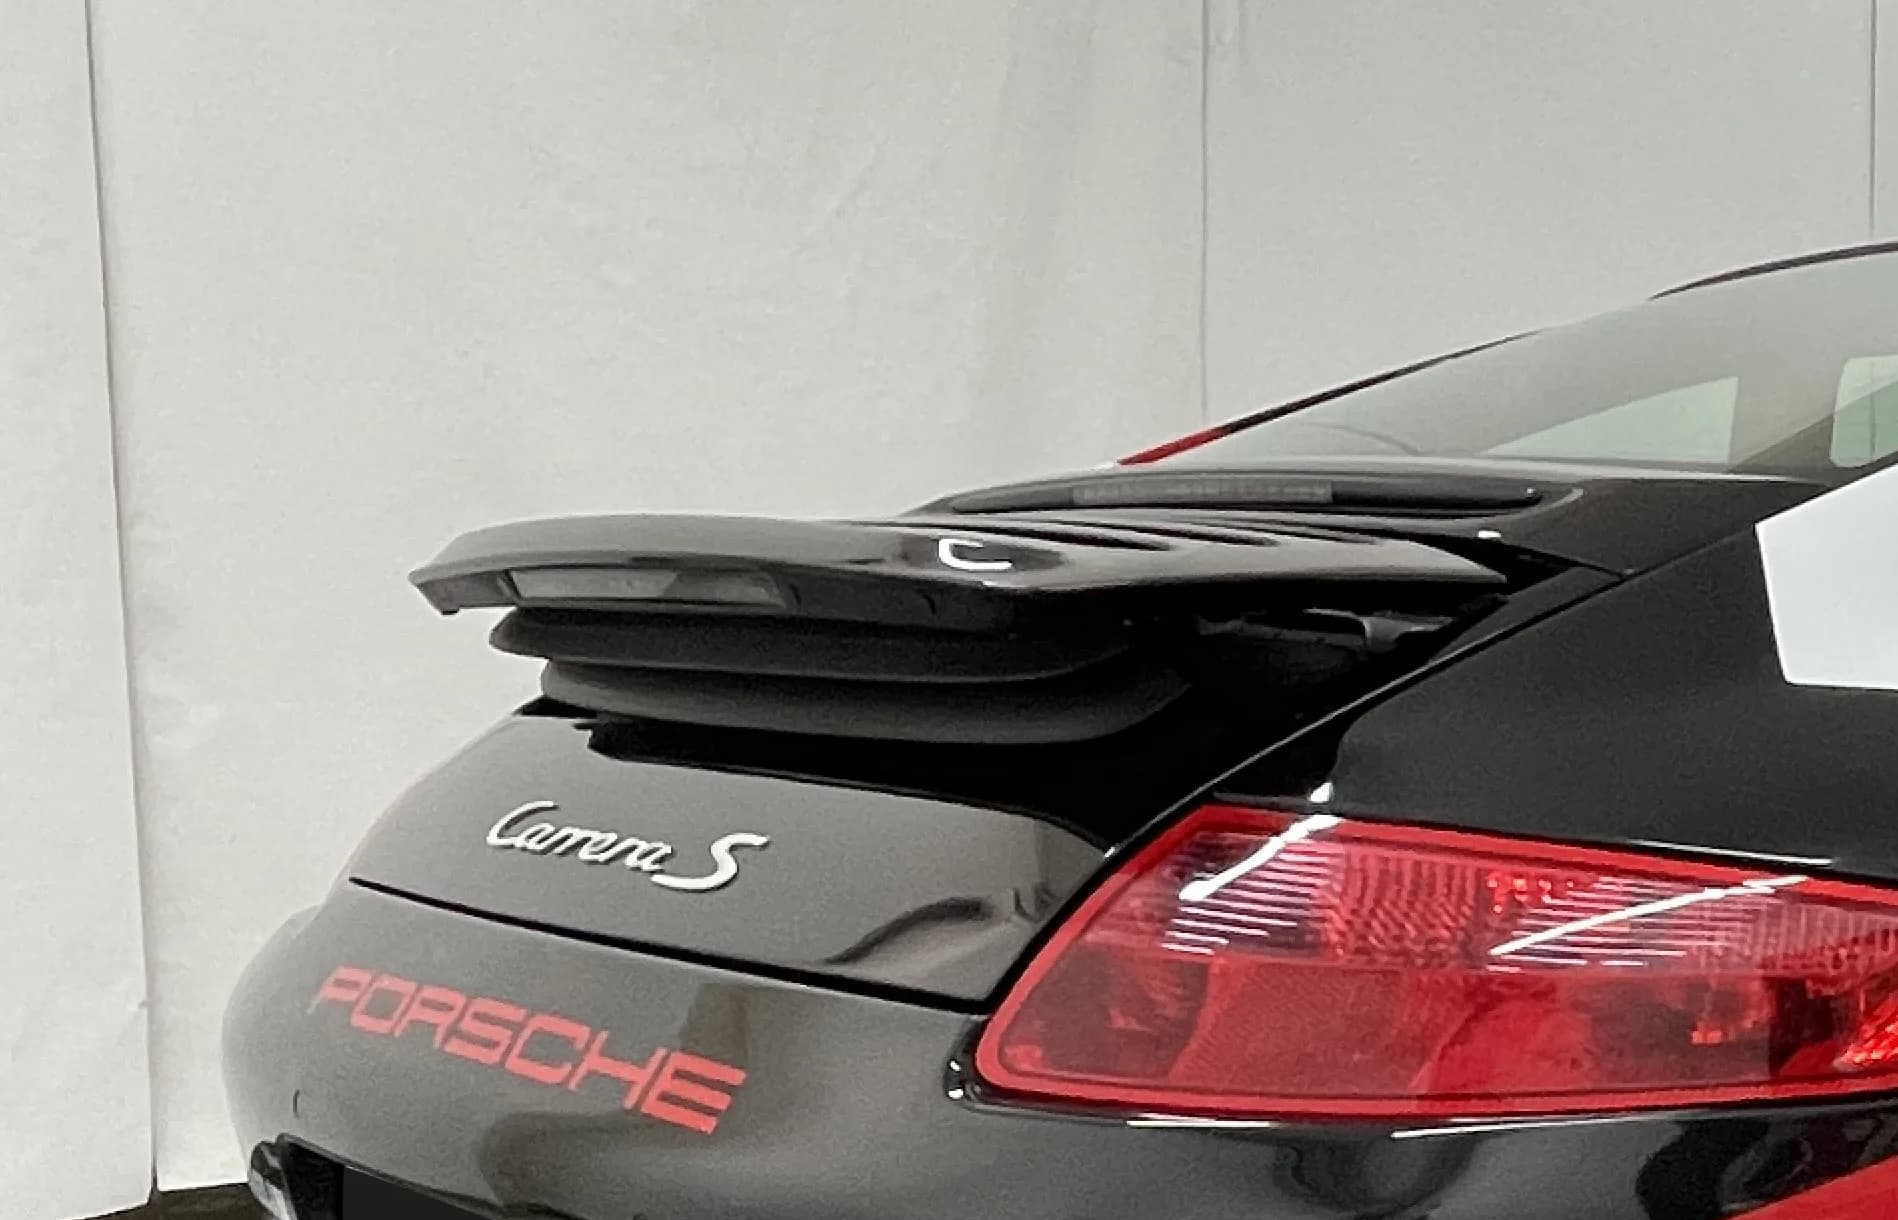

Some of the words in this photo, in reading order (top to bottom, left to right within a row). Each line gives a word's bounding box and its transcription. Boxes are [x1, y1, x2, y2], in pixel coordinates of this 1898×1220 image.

[487, 800, 673, 873] Carrera
[650, 831, 770, 893] S
[307, 965, 747, 1136] PORSCHE
